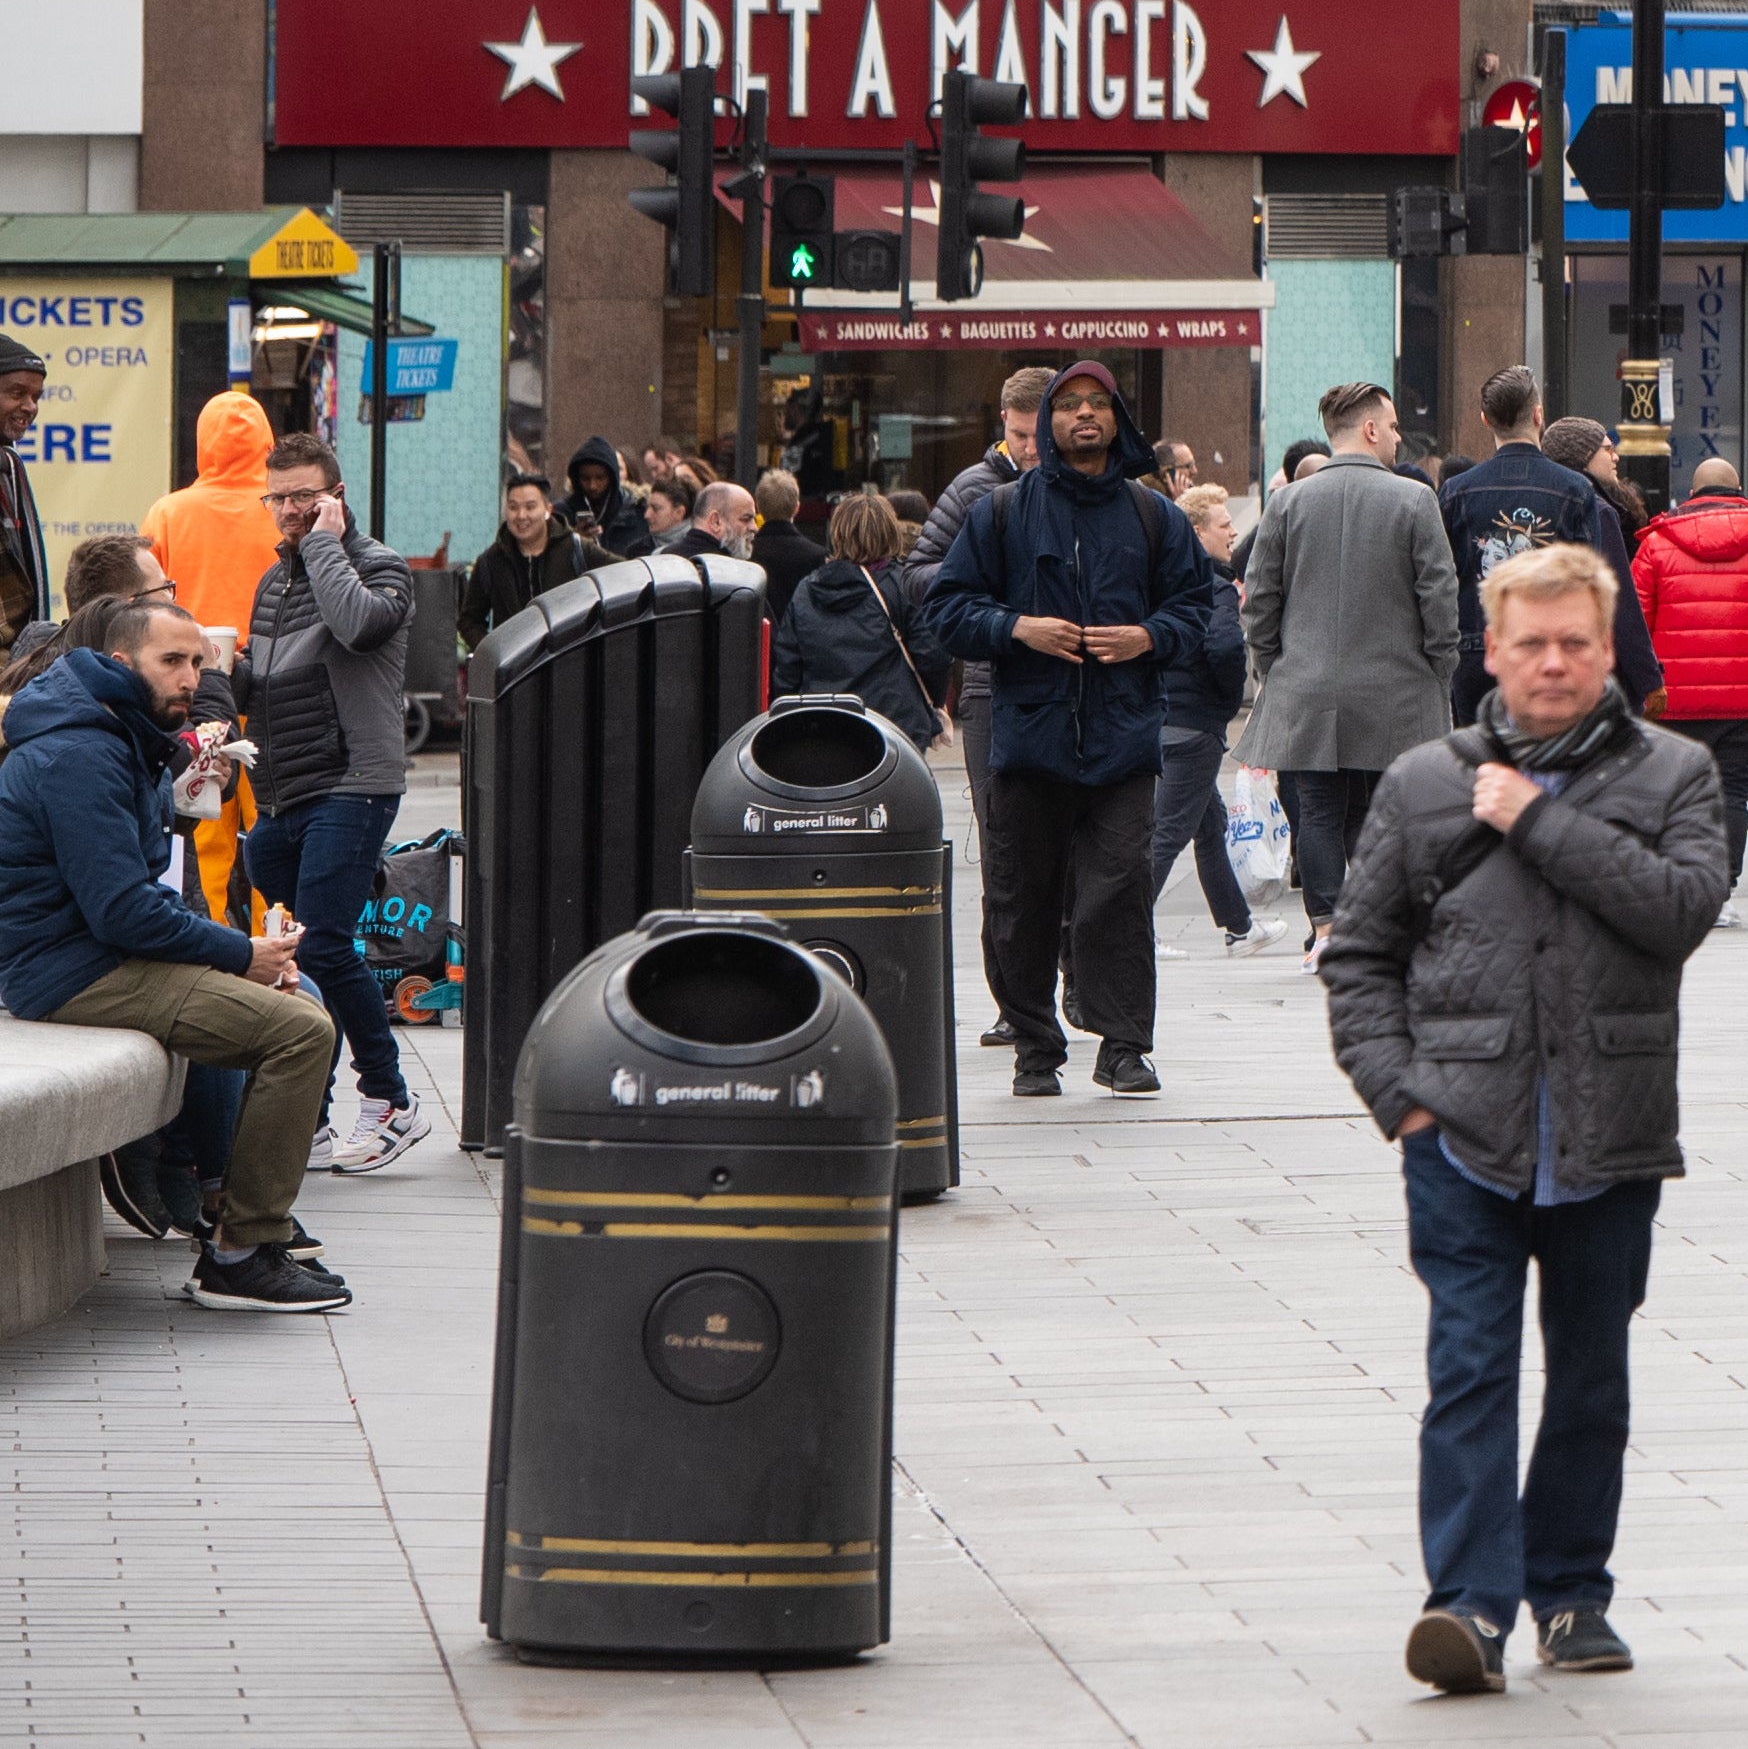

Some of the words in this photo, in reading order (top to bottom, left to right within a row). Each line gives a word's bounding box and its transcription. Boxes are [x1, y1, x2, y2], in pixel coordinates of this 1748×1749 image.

[276, 240, 305, 270] THEATRE
[307, 240, 334, 269] TICKETS
[0, 297, 145, 326] ICKETS
[836, 321, 929, 340] SANDWICHES
[960, 321, 1036, 340] BAGUETTES
[1061, 321, 1149, 339] CAPPUCCINO
[1177, 320, 1226, 338] WRAPS
[65, 346, 148, 367] OPERA
[397, 345, 444, 366] THEATRE
[396, 368, 438, 389] TICKETS
[41, 385, 76, 403] NFO.
[16, 424, 112, 462] ERE
[54, 523, 81, 535] THE
[773, 815, 824, 831] general
[827, 814, 858, 827] litter
[358, 896, 433, 933] MOR
[356, 923, 405, 938] ENTURE
[655, 1081, 731, 1105] general
[735, 1081, 781, 1102] litter
